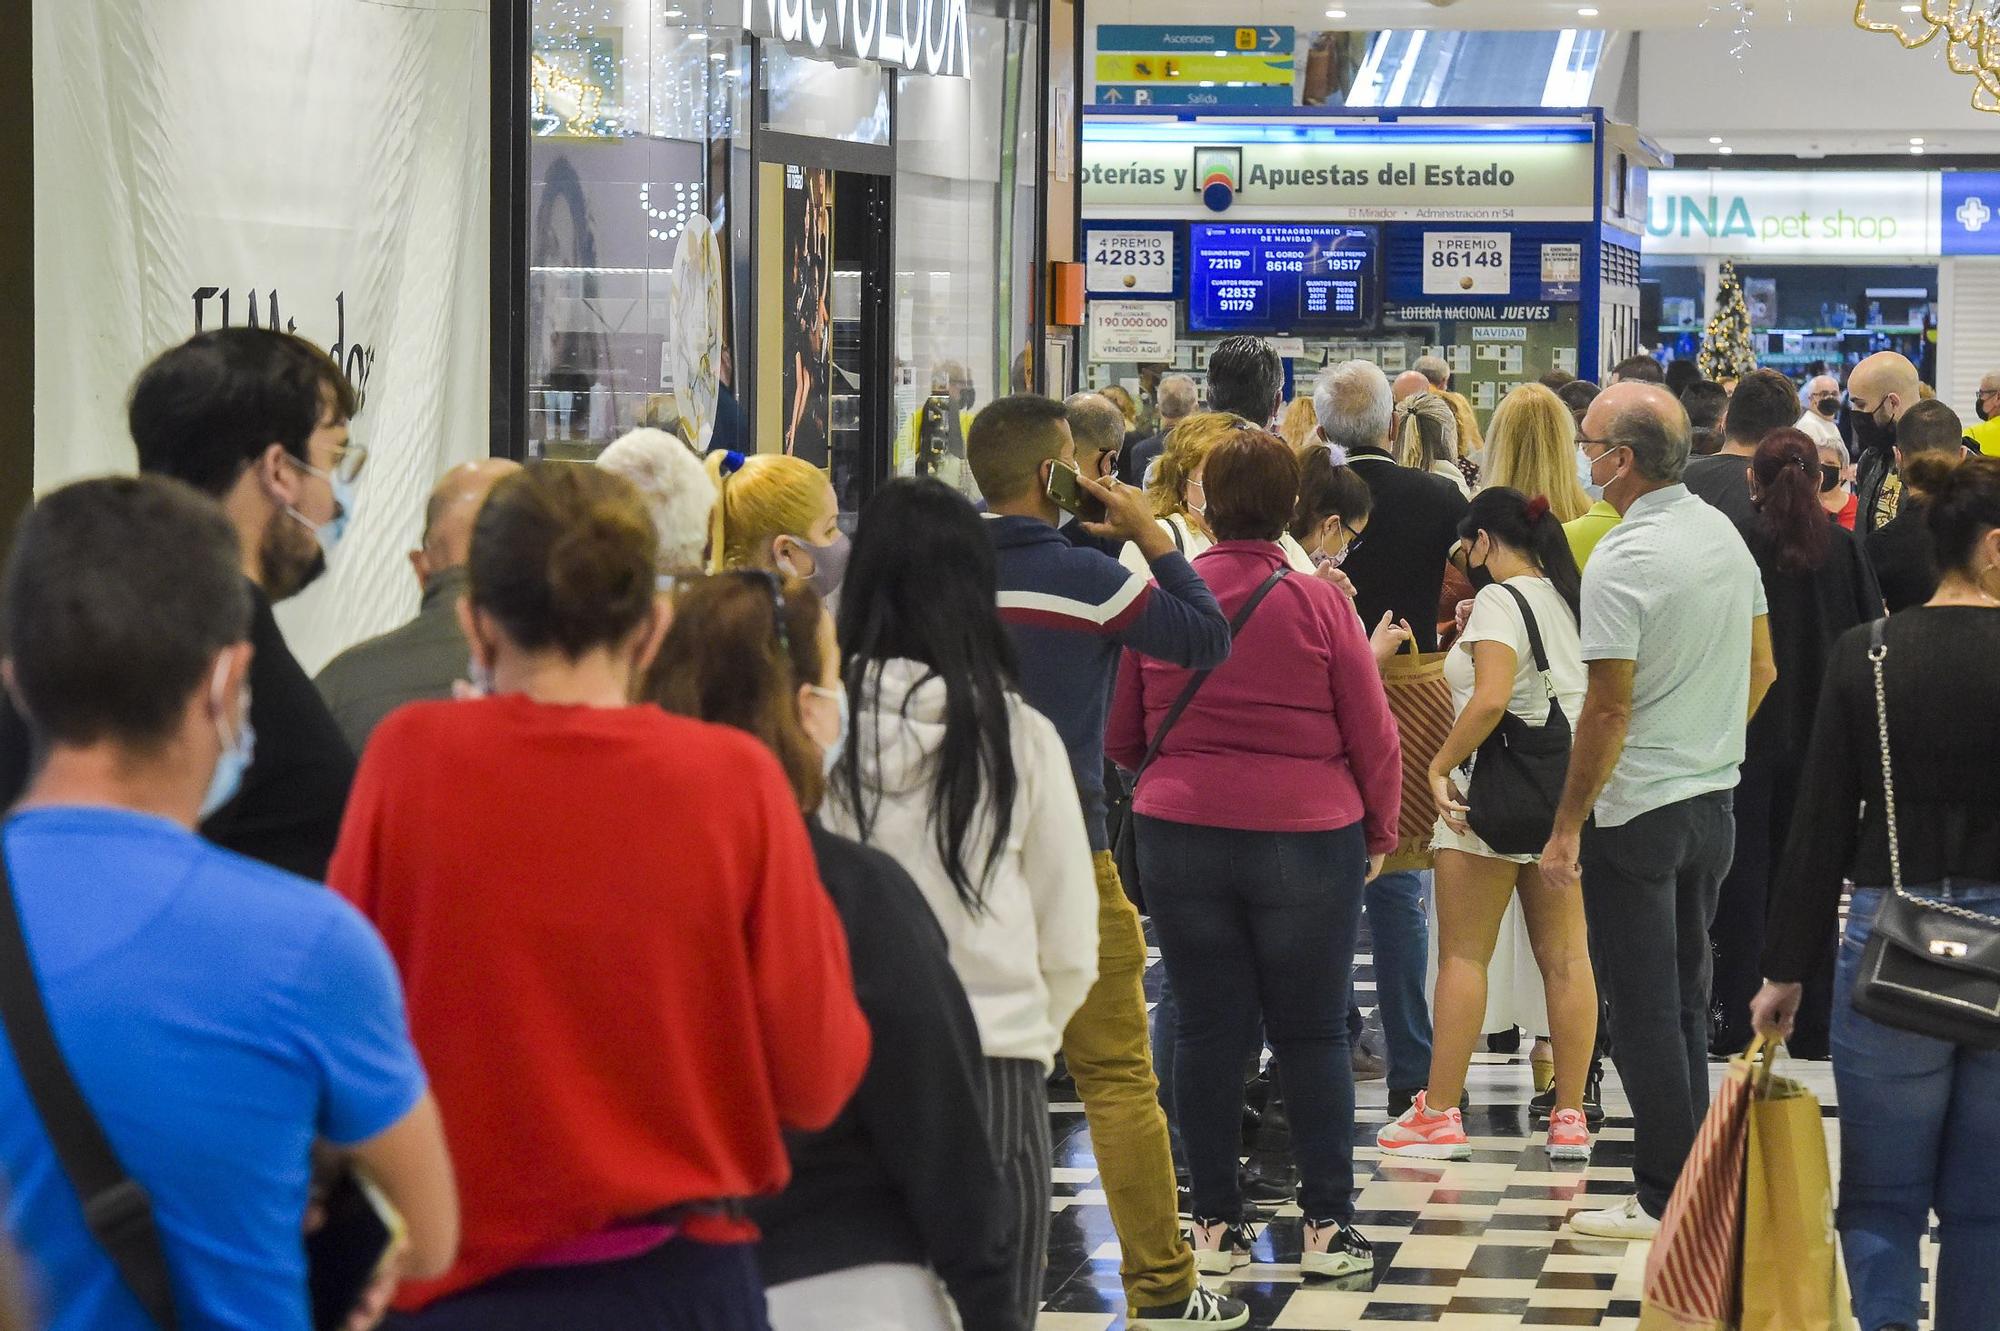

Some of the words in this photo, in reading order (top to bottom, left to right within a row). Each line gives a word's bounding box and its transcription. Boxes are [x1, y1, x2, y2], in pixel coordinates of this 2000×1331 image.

[1163, 34, 1214, 44] Ascensores
[1188, 93, 1218, 104] Salida
[1174, 168, 1188, 190] y
[1249, 164, 1368, 189] Apuestas
[1378, 162, 1415, 186] del
[1424, 163, 1514, 186] Estado
[1348, 208, 1358, 218] El
[1359, 208, 1398, 218] Mirador
[1416, 208, 1489, 218] Administración
[1762, 210, 1810, 242] pet
[1822, 208, 1896, 242] shop
[1112, 238, 1162, 248] PREMIO
[1447, 240, 1496, 249] PREMIO
[1095, 249, 1165, 266] 42833
[1432, 251, 1502, 268] 86148
[1208, 258, 1242, 269] 72119
[1266, 262, 1303, 272] 86148
[1328, 260, 1361, 270] 19517
[1218, 288, 1256, 298] 42833
[1220, 300, 1254, 311] 91179
[1401, 303, 1442, 320] LOTERÍA
[1444, 306, 1496, 320] NACIONAL
[1500, 306, 1550, 320] JUEVES
[1474, 328, 1525, 338] NAVIDAD
